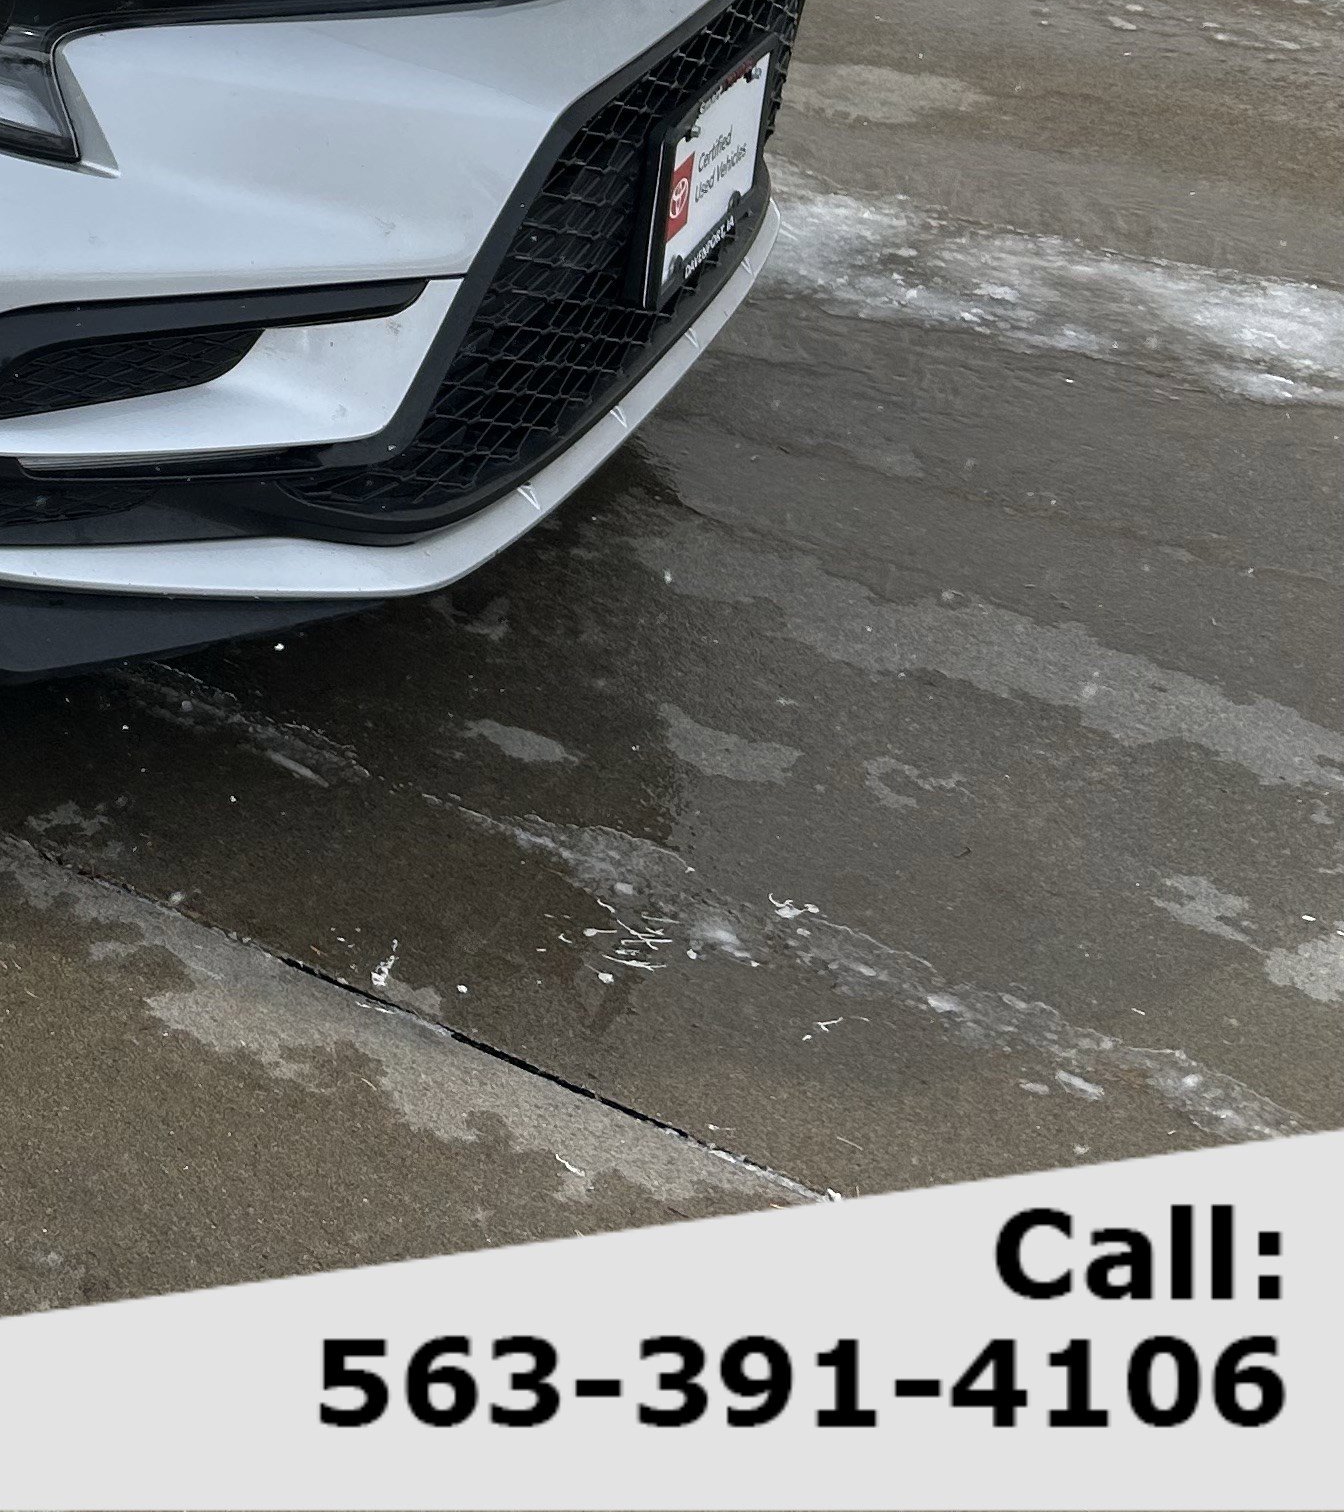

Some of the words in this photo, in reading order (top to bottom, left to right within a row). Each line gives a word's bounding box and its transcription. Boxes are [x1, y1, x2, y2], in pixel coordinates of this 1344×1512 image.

[694, 171, 715, 204] Used
[716, 142, 748, 183] Vehicles
[698, 124, 733, 174] Certified
